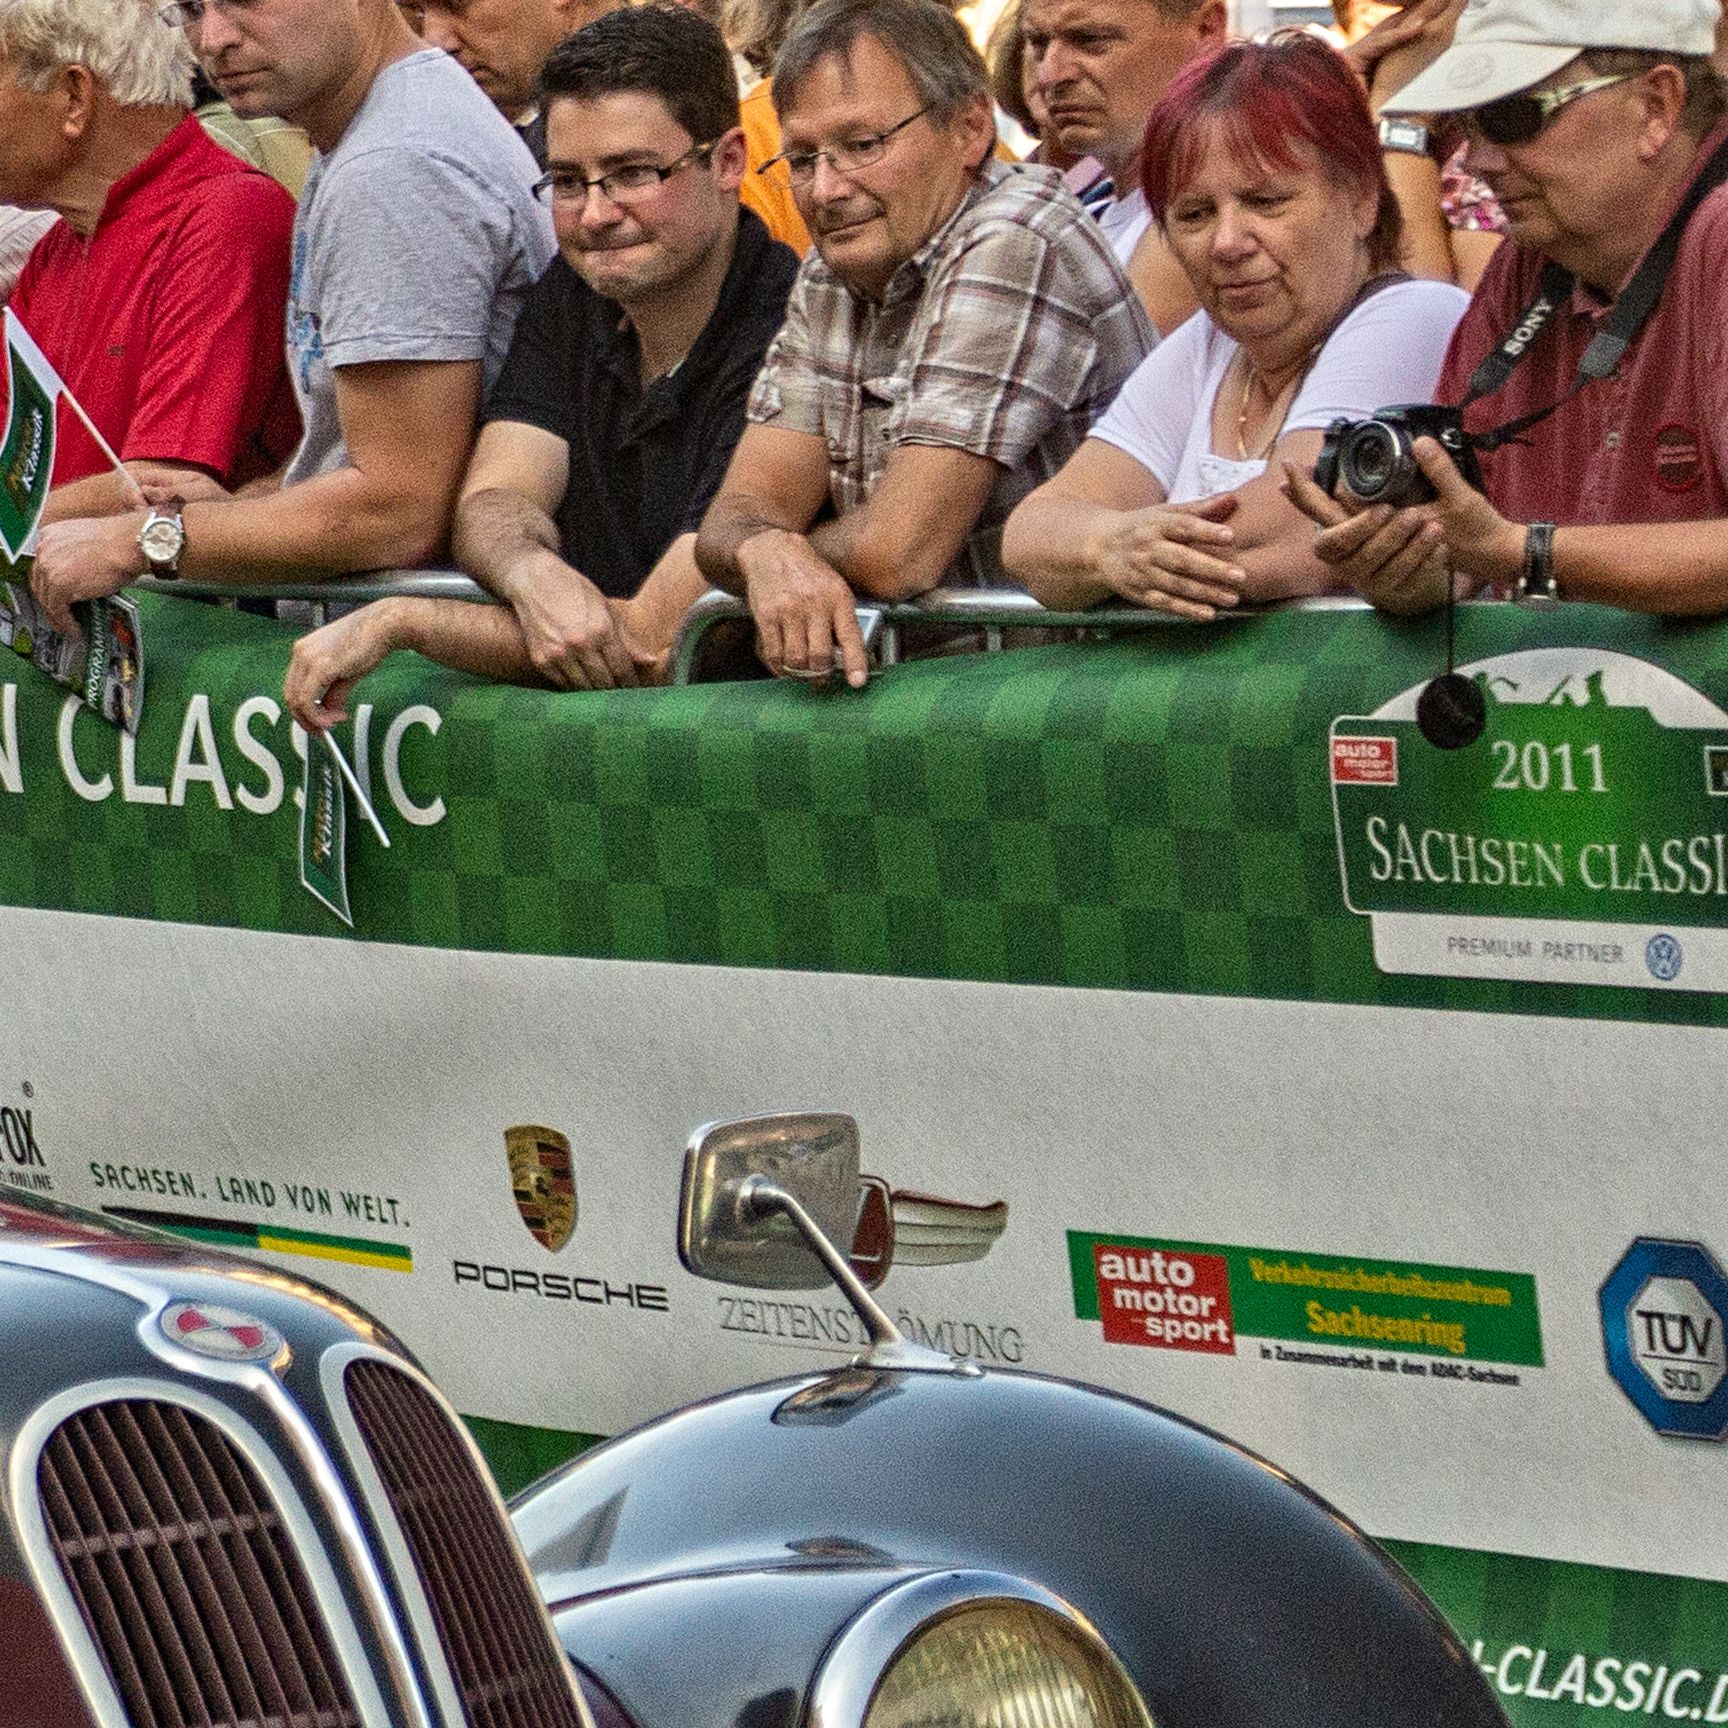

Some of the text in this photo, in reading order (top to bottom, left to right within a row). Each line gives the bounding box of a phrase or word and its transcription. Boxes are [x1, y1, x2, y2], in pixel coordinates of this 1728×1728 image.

[1504, 298, 1552, 355] SONY
[1491, 740, 1609, 792] 2011
[1366, 816, 1565, 886] SACHSEN
[1447, 936, 1624, 963] PREMIUM PARTNER
[217, 1176, 276, 1208] LAND
[284, 1184, 332, 1216] VON
[453, 1260, 669, 1312] PORSCHE
[1100, 1251, 1194, 1287] auto
[1112, 1286, 1217, 1317] motor
[1145, 1316, 1230, 1344] sport
